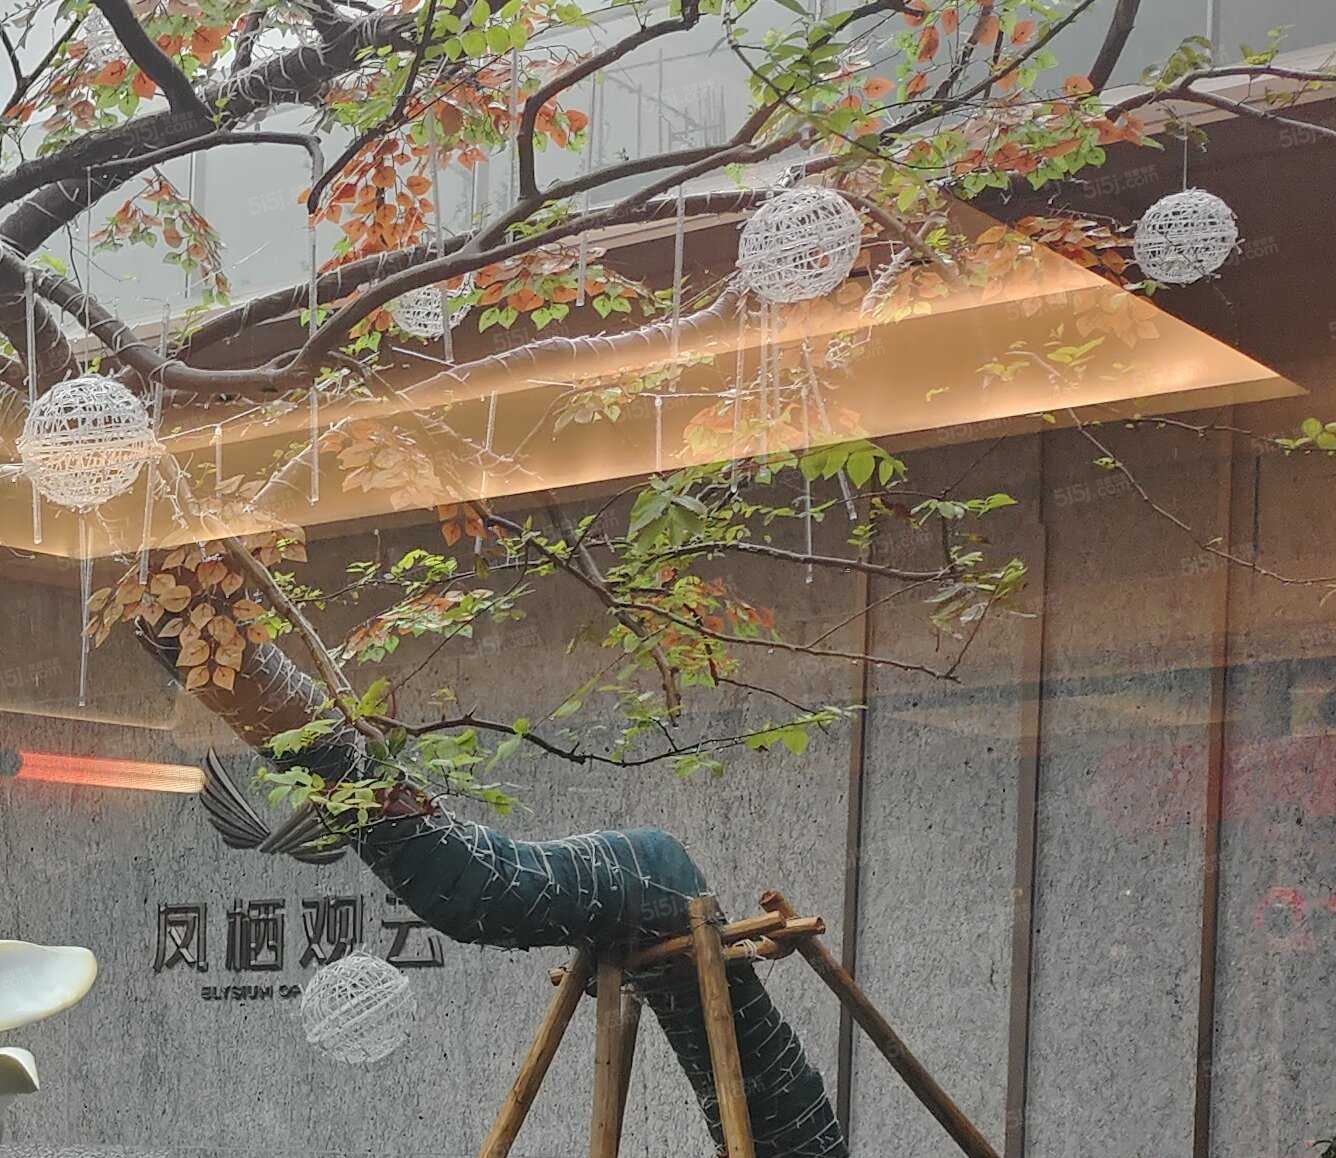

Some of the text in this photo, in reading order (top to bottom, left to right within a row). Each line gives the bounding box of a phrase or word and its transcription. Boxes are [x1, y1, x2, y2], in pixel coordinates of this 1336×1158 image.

[154, 894, 444, 971] 凤栖观云
[201, 984, 274, 1000] ELYSIUM
